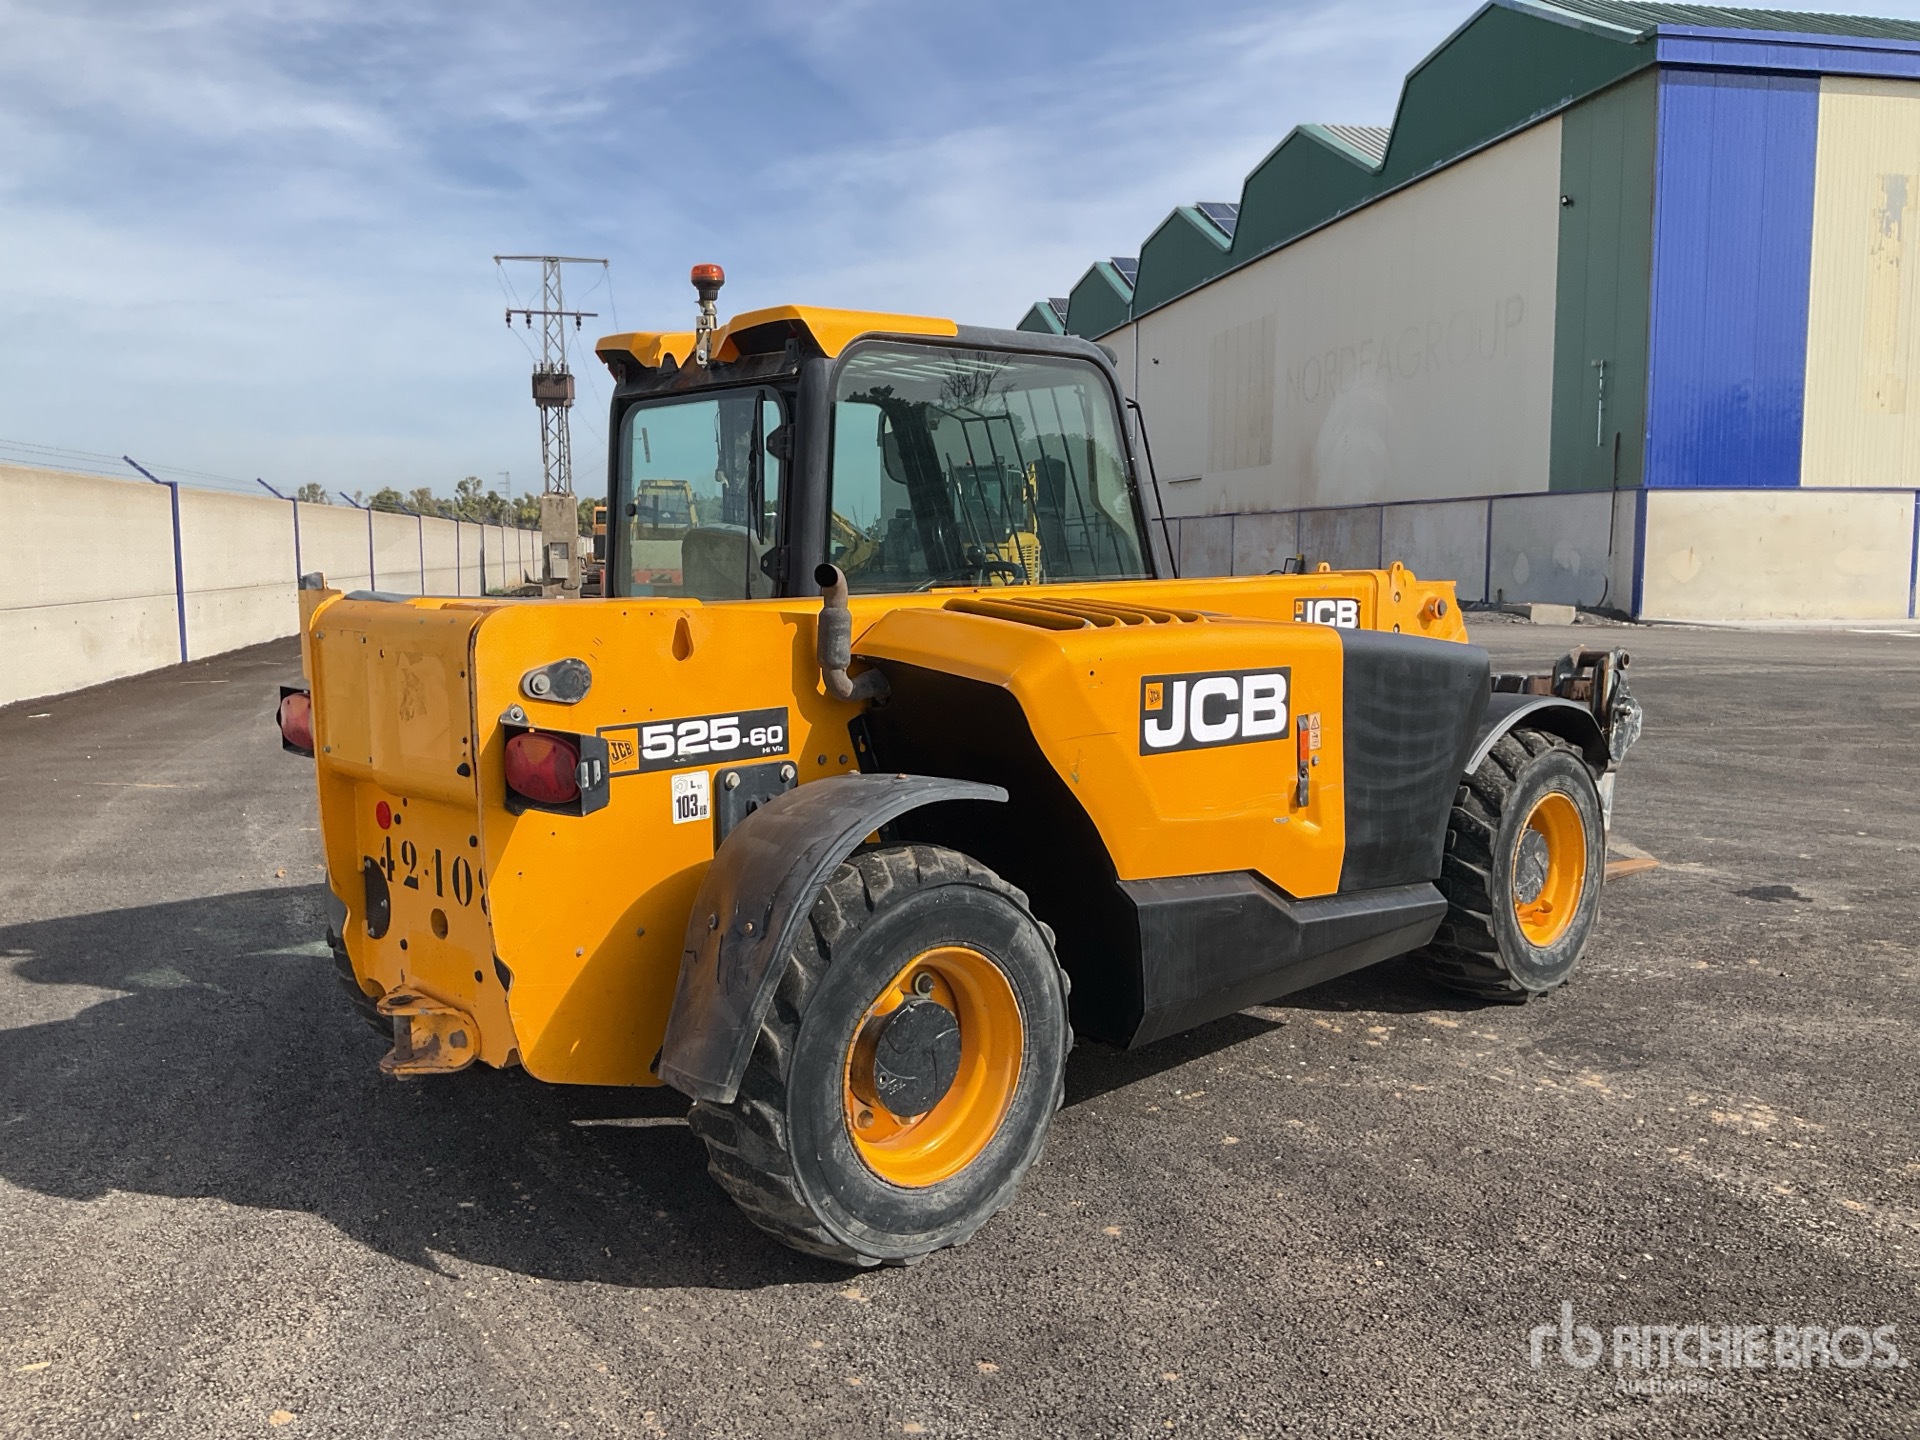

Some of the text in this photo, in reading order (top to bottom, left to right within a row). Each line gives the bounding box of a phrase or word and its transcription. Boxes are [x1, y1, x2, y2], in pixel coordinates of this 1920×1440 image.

[1295, 600, 1358, 628] JCB
[1145, 673, 1287, 748] JCB
[610, 742, 632, 761] JCB
[642, 716, 783, 760] 525-60
[676, 793, 699, 819] 103
